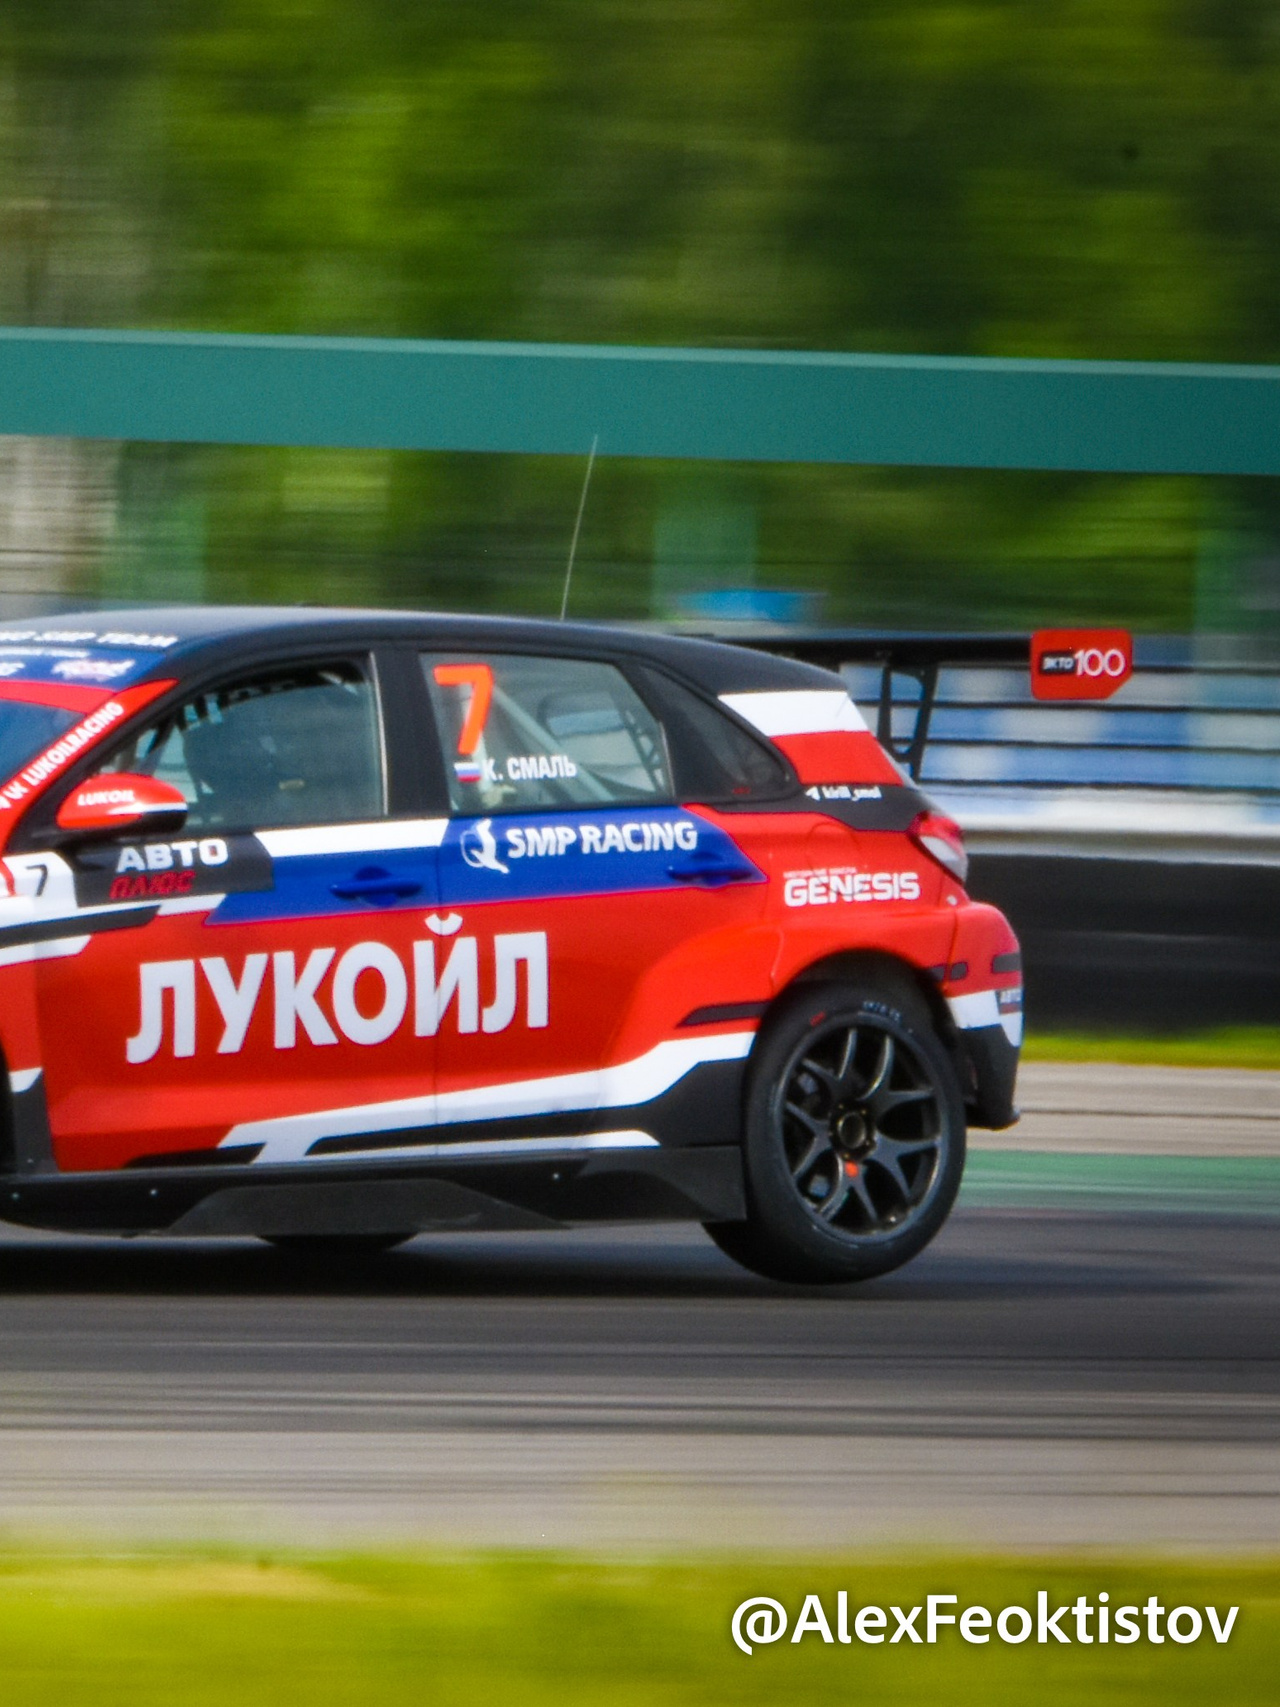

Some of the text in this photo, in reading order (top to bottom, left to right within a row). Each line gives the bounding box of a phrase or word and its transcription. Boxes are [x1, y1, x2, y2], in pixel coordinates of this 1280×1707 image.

[1073, 648, 1125, 677] 100
[433, 664, 495, 755] 7
[483, 755, 577, 781] К. СМАЛЬ
[77, 789, 135, 806] LUKOIL
[115, 838, 228, 873] АВТО
[506, 821, 698, 858] SMP RACING
[25, 864, 48, 897] 7
[109, 869, 197, 899] ПЛЮС
[784, 872, 920, 907] GENESIS
[126, 912, 549, 1064] ЛУКОЙЛ
